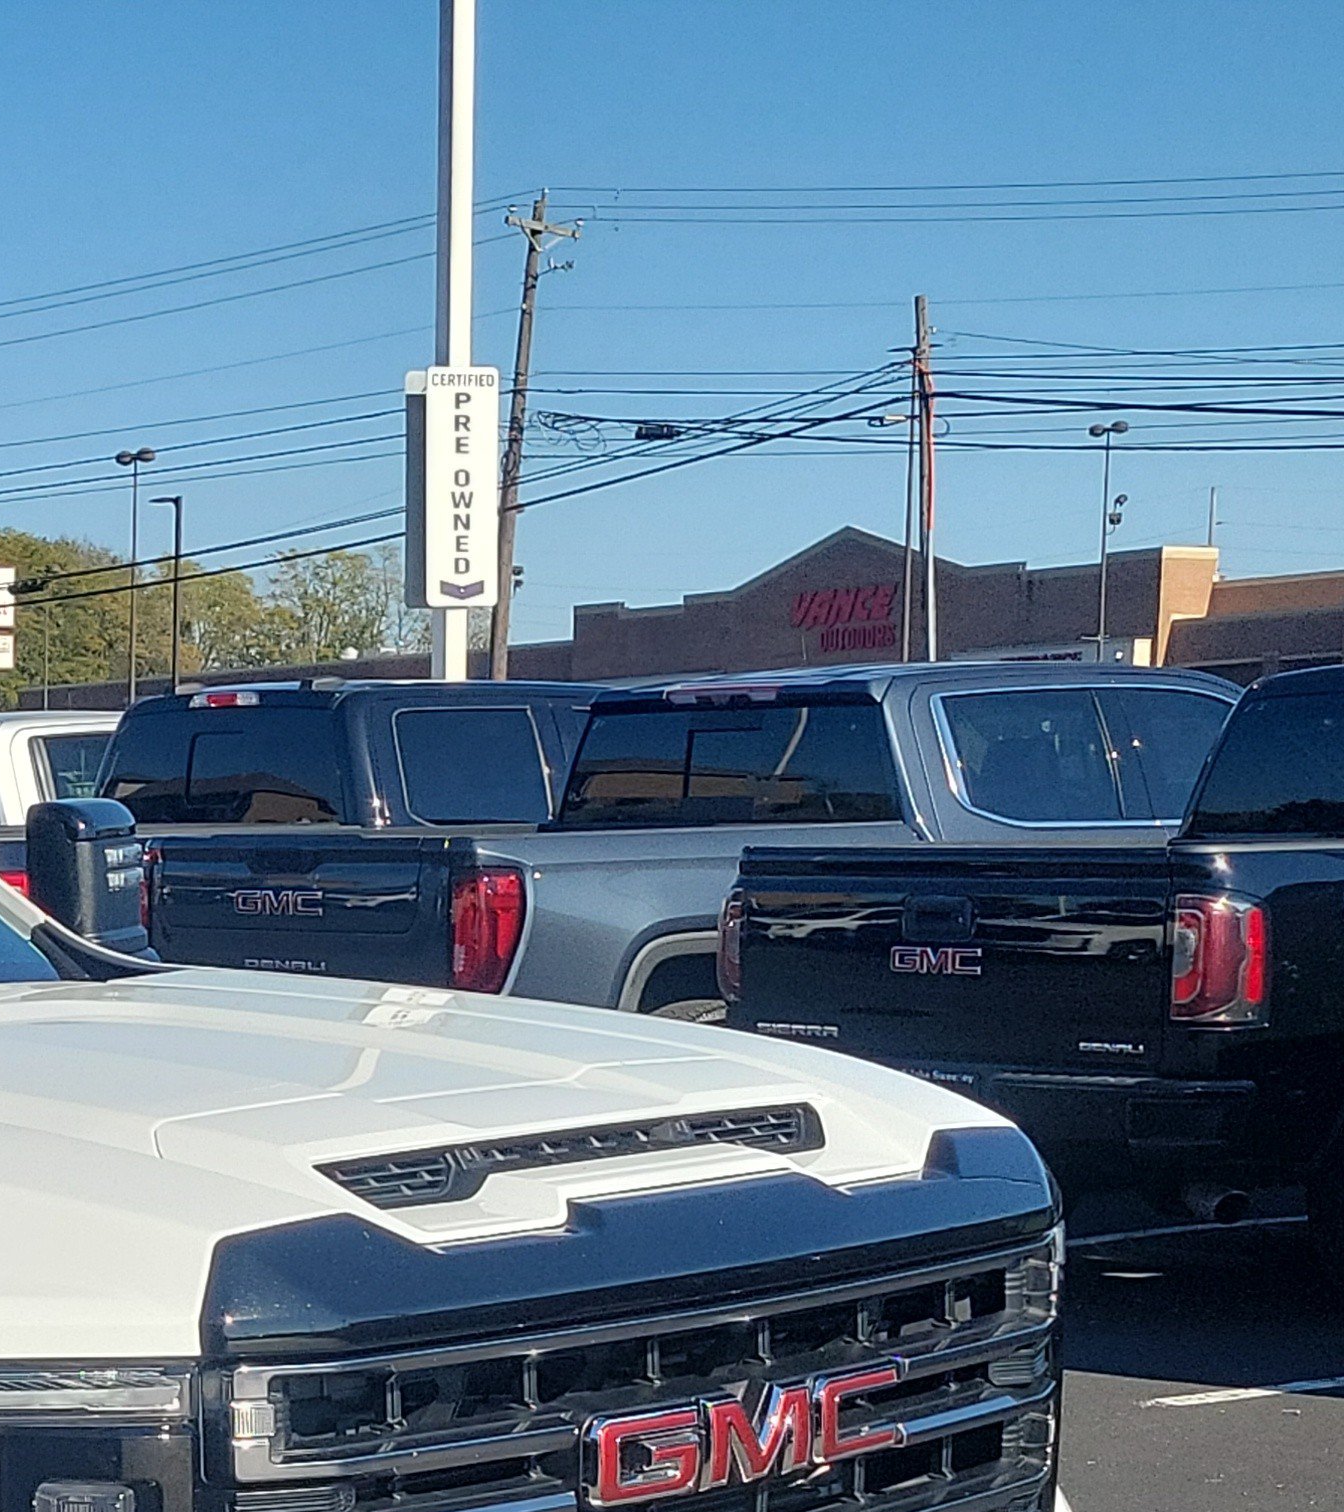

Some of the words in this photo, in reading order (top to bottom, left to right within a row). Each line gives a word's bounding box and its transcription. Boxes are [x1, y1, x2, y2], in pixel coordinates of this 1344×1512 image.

[431, 373, 495, 388] CERTIFIED
[454, 391, 472, 455] PRE
[450, 468, 474, 576] OWNED
[792, 585, 898, 628] VANCE
[820, 624, 896, 652] OUTDOORS
[233, 889, 323, 917] GMC
[244, 958, 326, 972] DENALI
[889, 945, 982, 975] GMC
[756, 1021, 839, 1038] SIERRA
[1078, 1042, 1144, 1054] DENALI
[580, 1362, 902, 1508] GMC
